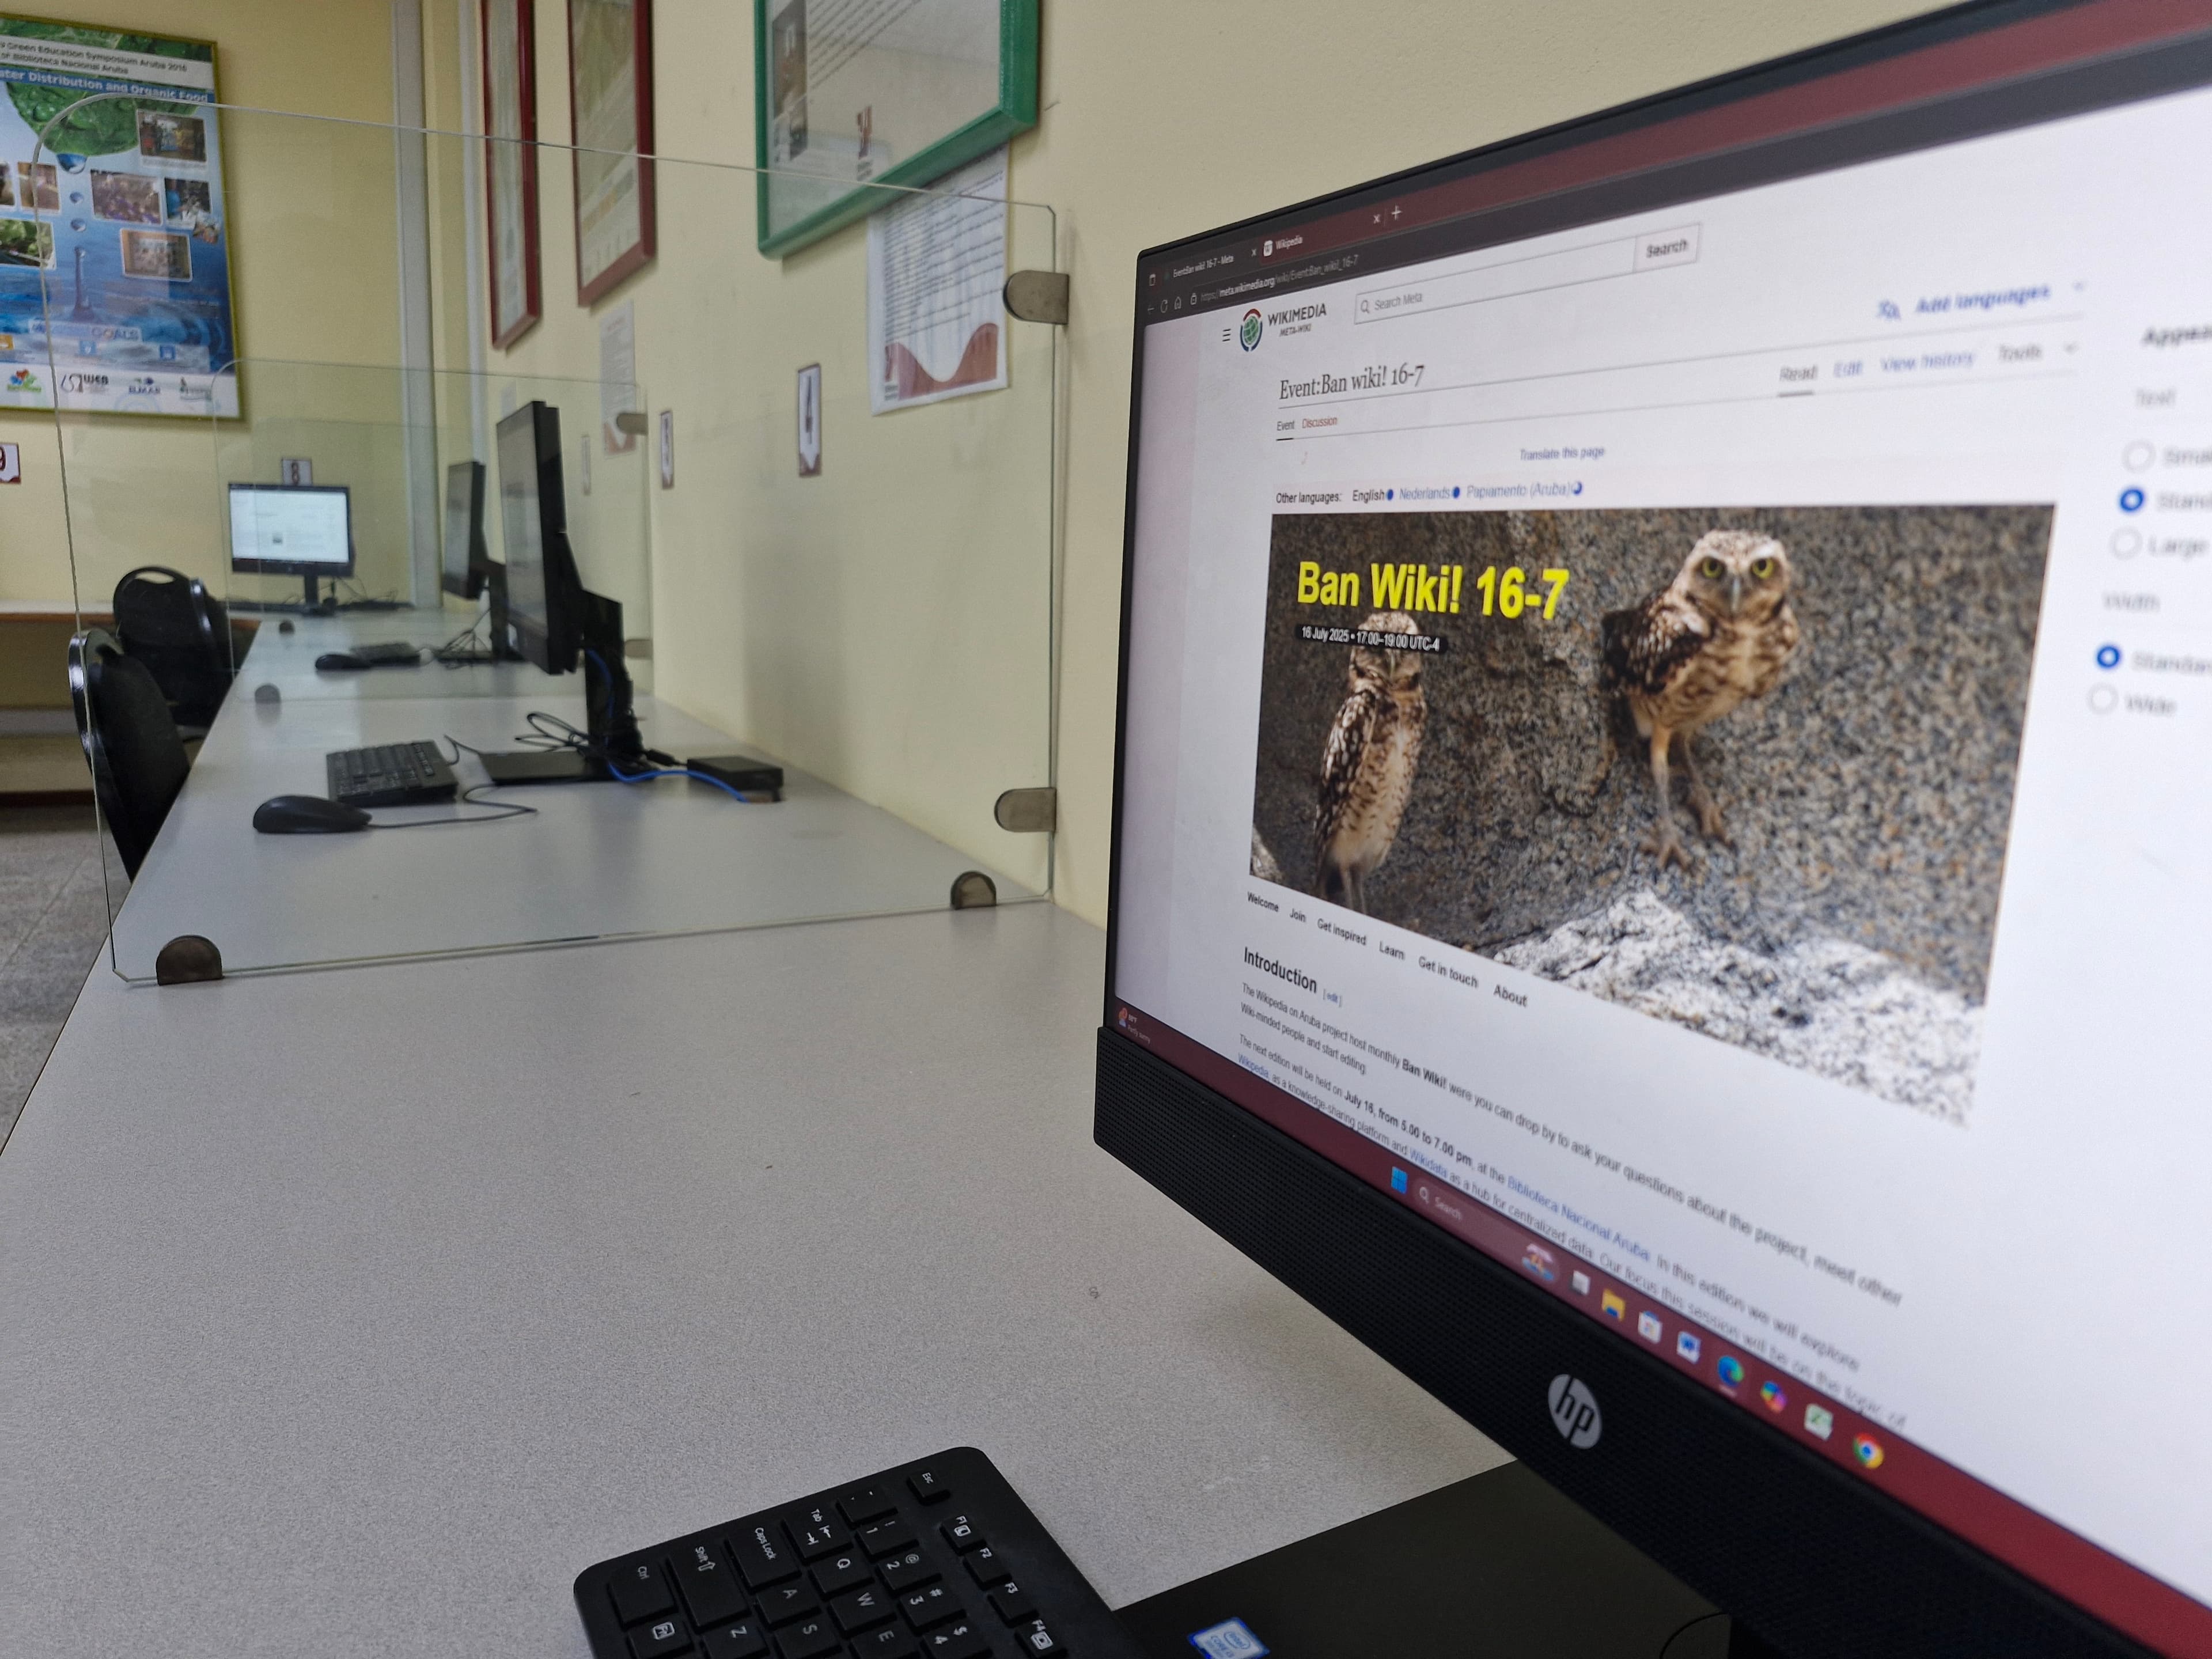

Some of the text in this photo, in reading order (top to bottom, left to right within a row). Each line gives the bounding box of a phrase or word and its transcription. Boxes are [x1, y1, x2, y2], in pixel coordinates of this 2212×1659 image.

[29, 71, 208, 104] Distribution and Organic Food
[1275, 236, 1304, 250] Wikipedia
[1646, 238, 1688, 259] Search
[1374, 291, 1423, 311] Search Meta
[1915, 284, 2052, 315] Add languages
[1267, 302, 1327, 326] WIKIMEDIA
[1279, 323, 1312, 337] META-WIKI
[1779, 343, 2043, 382] Read Edit View history Tools
[1279, 362, 1426, 400] Event:Ban wiki! 16-7
[1277, 415, 1338, 431] Event Discussion
[1520, 446, 1605, 461] Translate this page
[1276, 480, 1571, 506] Other languages: English Nederlands Papiamento (Aruba)
[2149, 536, 2209, 560] Large
[1297, 560, 1570, 620] Ban Wiki! 16-7
[1302, 626, 1440, 652] 16 July 2025 UTC-4
[1247, 891, 1528, 1008] Welcome Join Get inspired Learn Get in touch About
[1244, 946, 1317, 994] Introduction
[1240, 1001, 1339, 1060] Wiki-minded people and start
[1243, 982, 1255, 997] The
[1256, 987, 1288, 1014] Wikipedia
[1289, 1007, 1298, 1018] on
[1298, 1010, 1321, 1029] Aruba
[1321, 1022, 1348, 1044] project
[1349, 1032, 1367, 1051] host
[1368, 1044, 1401, 1069] monthly
[1402, 1058, 1421, 1078] Ban
[1423, 1067, 1448, 1089] Wiki!
[1449, 1081, 1472, 1102] were
[1474, 1094, 1493, 1113] you
[1494, 1104, 1513, 1122] can
[1515, 1113, 1539, 1136] drop
[1541, 1123, 1556, 1143] by
[1558, 1131, 1570, 1148] to
[1571, 1139, 1592, 1159] ask
[1594, 1151, 1621, 1173] your
[1623, 1165, 1684, 1205] questions
[1687, 1194, 1727, 1226] about
[1729, 1211, 1753, 1236] the
[1858, 1274, 1903, 1307] other
[1239, 1033, 1252, 1049] The
[1252, 1040, 1267, 1056] next
[1268, 1047, 1291, 1070] edition
[1291, 1061, 1303, 1077] will
[1304, 1067, 1314, 1082] be
[1315, 1074, 1331, 1092] held
[1332, 1084, 1343, 1097] on
[1344, 1089, 1362, 1109] July
[1378, 1107, 1399, 1128] from
[1401, 1119, 1420, 1139] 5.00
[1422, 1129, 1432, 1145] to
[1433, 1135, 1454, 1158] 7.00
[1477, 1161, 1488, 1175] at
[1489, 1165, 1506, 1184] the
[1507, 1175, 1559, 1214] Biblioteca
[1560, 1203, 1612, 1241] Nacional
[1672, 1262, 1695, 1287] this
[1698, 1274, 1746, 1313] edition
[1271, 1072, 1281, 1085] as
[1357, 1120, 1389, 1147] platform
[1391, 1138, 1408, 1156] and
[1409, 1146, 1448, 1179] Wikidata
[1449, 1169, 1461, 1185] as
[1471, 1181, 1490, 1202] hub
[1491, 1190, 1506, 1210] for
[1508, 1202, 1566, 1244] centralized
[1599, 1252, 1622, 1273] Our
[1625, 1267, 1658, 1294] focus
[1661, 1285, 1684, 1309] this
[1687, 1301, 1740, 1340] session
[1551, 1374, 1599, 1447] hp
[922, 1472, 934, 1484] Esc
[810, 1508, 824, 1523] Tab
[955, 1515, 968, 1525] F1
[754, 1527, 777, 1560] Caps Lock
[695, 1546, 710, 1563] Shift
[904, 1553, 920, 1565] @
[979, 1547, 993, 1559] F2
[836, 1558, 851, 1570] Q
[886, 1560, 900, 1570] 2
[637, 1565, 650, 1580] Ctrl
[783, 1588, 798, 1600] A
[1004, 1581, 1020, 1594] F3
[857, 1592, 875, 1607] W
[910, 1595, 925, 1606] 3
[730, 1625, 748, 1639] Z
[802, 1623, 818, 1635] S
[878, 1630, 895, 1642] E
[934, 1635, 949, 1646] 4
